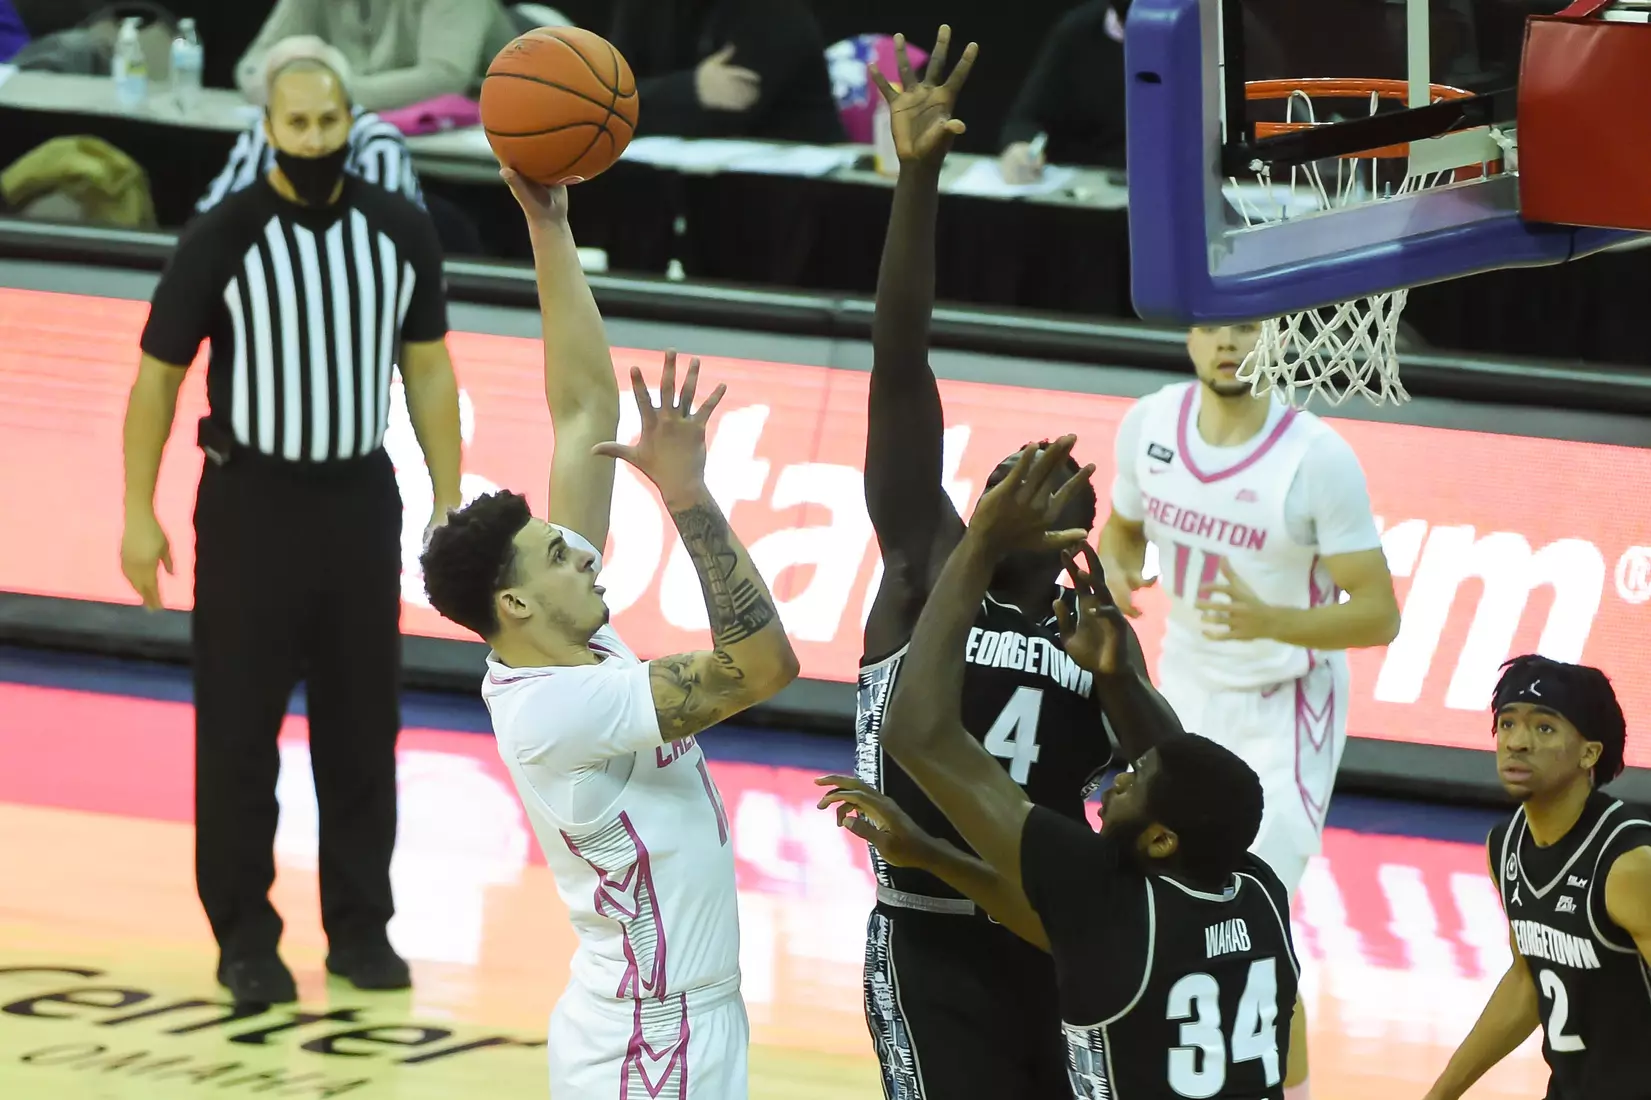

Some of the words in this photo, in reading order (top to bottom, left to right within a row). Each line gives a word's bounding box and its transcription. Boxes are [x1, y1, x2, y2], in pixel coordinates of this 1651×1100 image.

[1141, 491, 1268, 552] REIGHTON
[965, 626, 1094, 700] EORGETOWN
[983, 685, 1044, 786] 4
[1204, 918, 1252, 959] WAHAB
[1510, 919, 1602, 970] EORGETOWN
[1165, 956, 1281, 1099] 34
[1538, 968, 1587, 1052] 2
